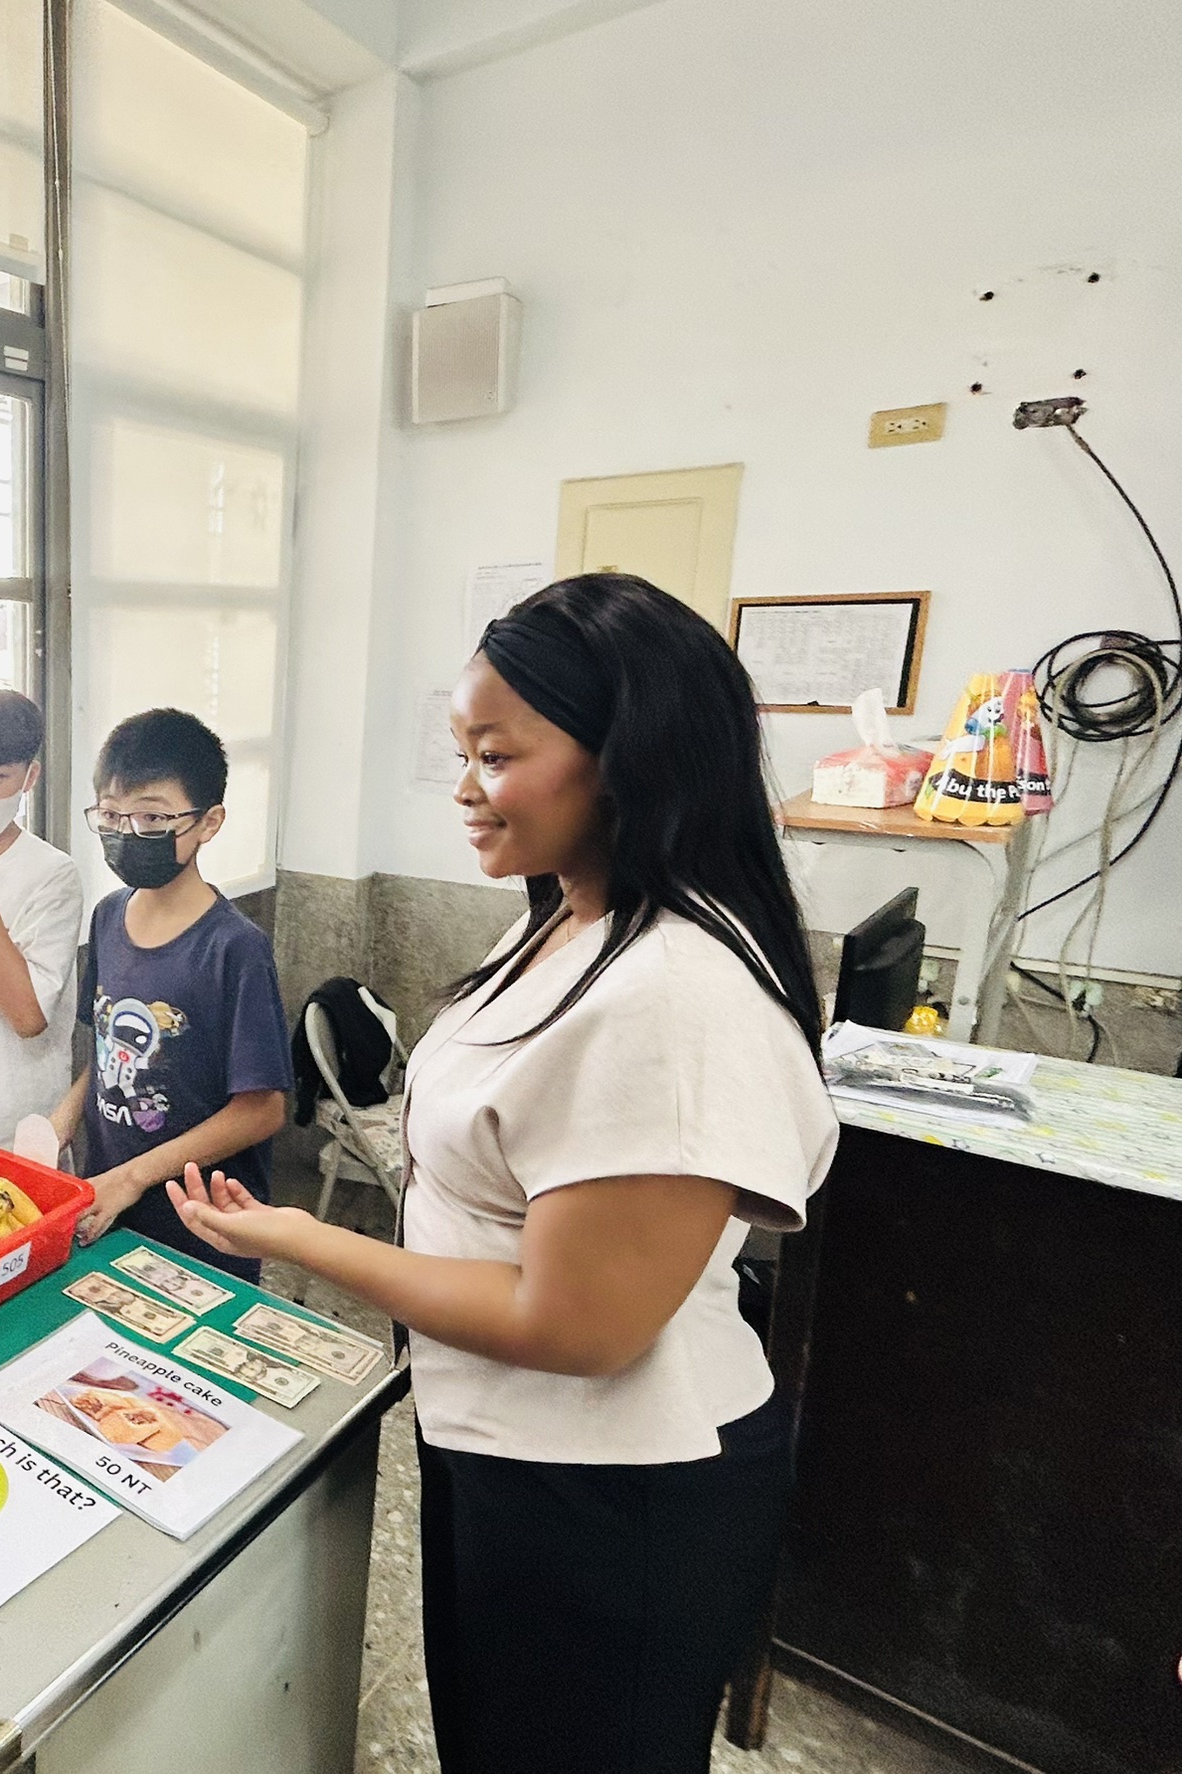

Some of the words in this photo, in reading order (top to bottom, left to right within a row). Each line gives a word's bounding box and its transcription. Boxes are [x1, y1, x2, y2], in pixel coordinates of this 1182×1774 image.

[977, 783, 1007, 799] the
[105, 1341, 181, 1383] Pineapple
[183, 1380, 223, 1407] cake
[15, 1452, 37, 1472] is
[36, 1467, 96, 1511] that?
[95, 1456, 121, 1475] 50
[121, 1474, 152, 1495] NT
